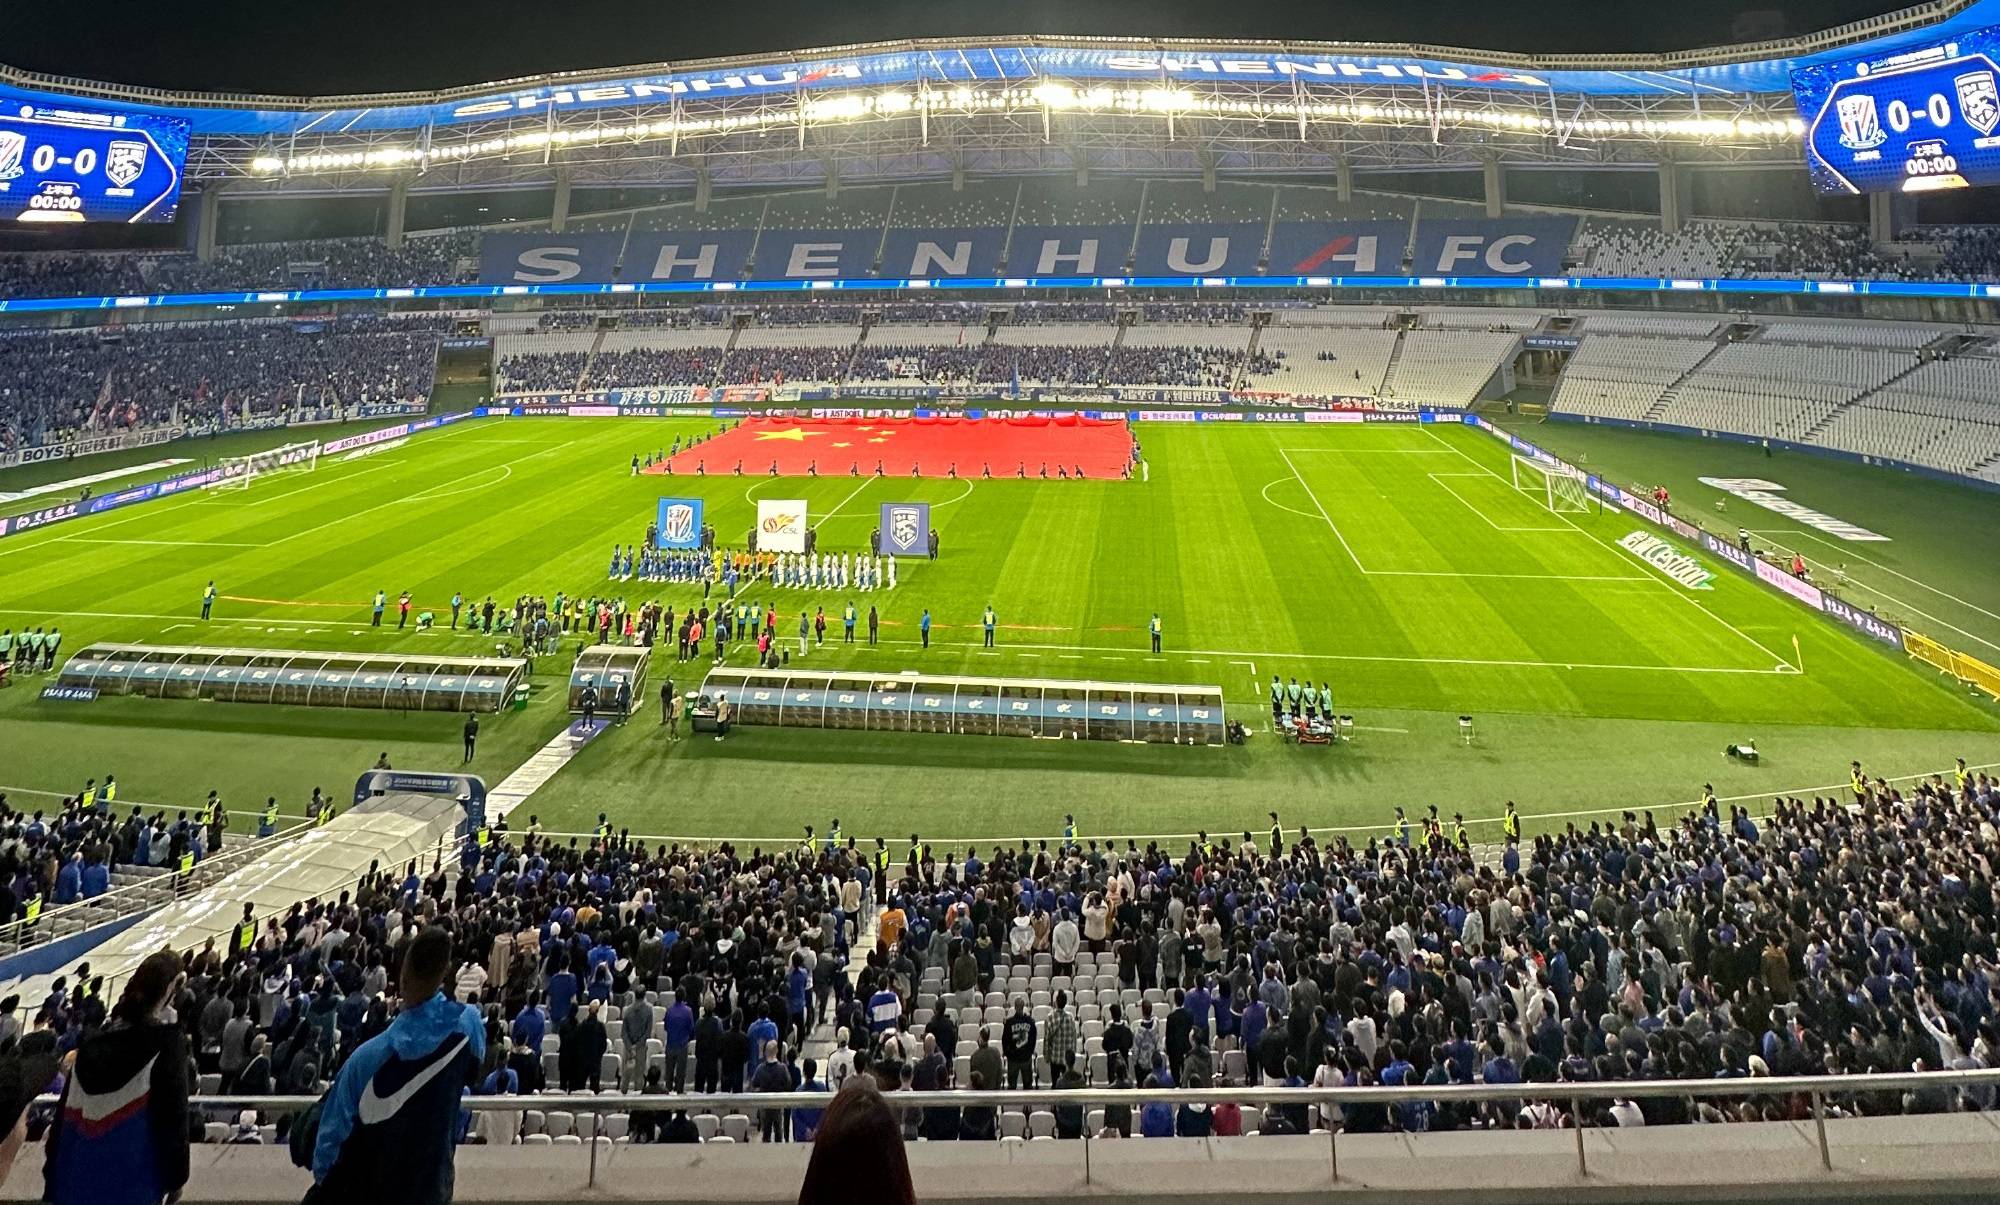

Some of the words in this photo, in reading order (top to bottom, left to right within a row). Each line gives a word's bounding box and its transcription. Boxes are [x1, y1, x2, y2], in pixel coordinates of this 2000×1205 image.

[1107, 56, 1549, 87] SHENHUA
[453, 65, 863, 117] SHENHUA
[1888, 93, 1951, 132] 0-0
[32, 145, 97, 175] 0-0
[1906, 155, 1957, 174] 00:00
[30, 195, 81, 209] 00:00
[1436, 234, 1536, 274] FC
[22, 445, 65, 463] BOYS
